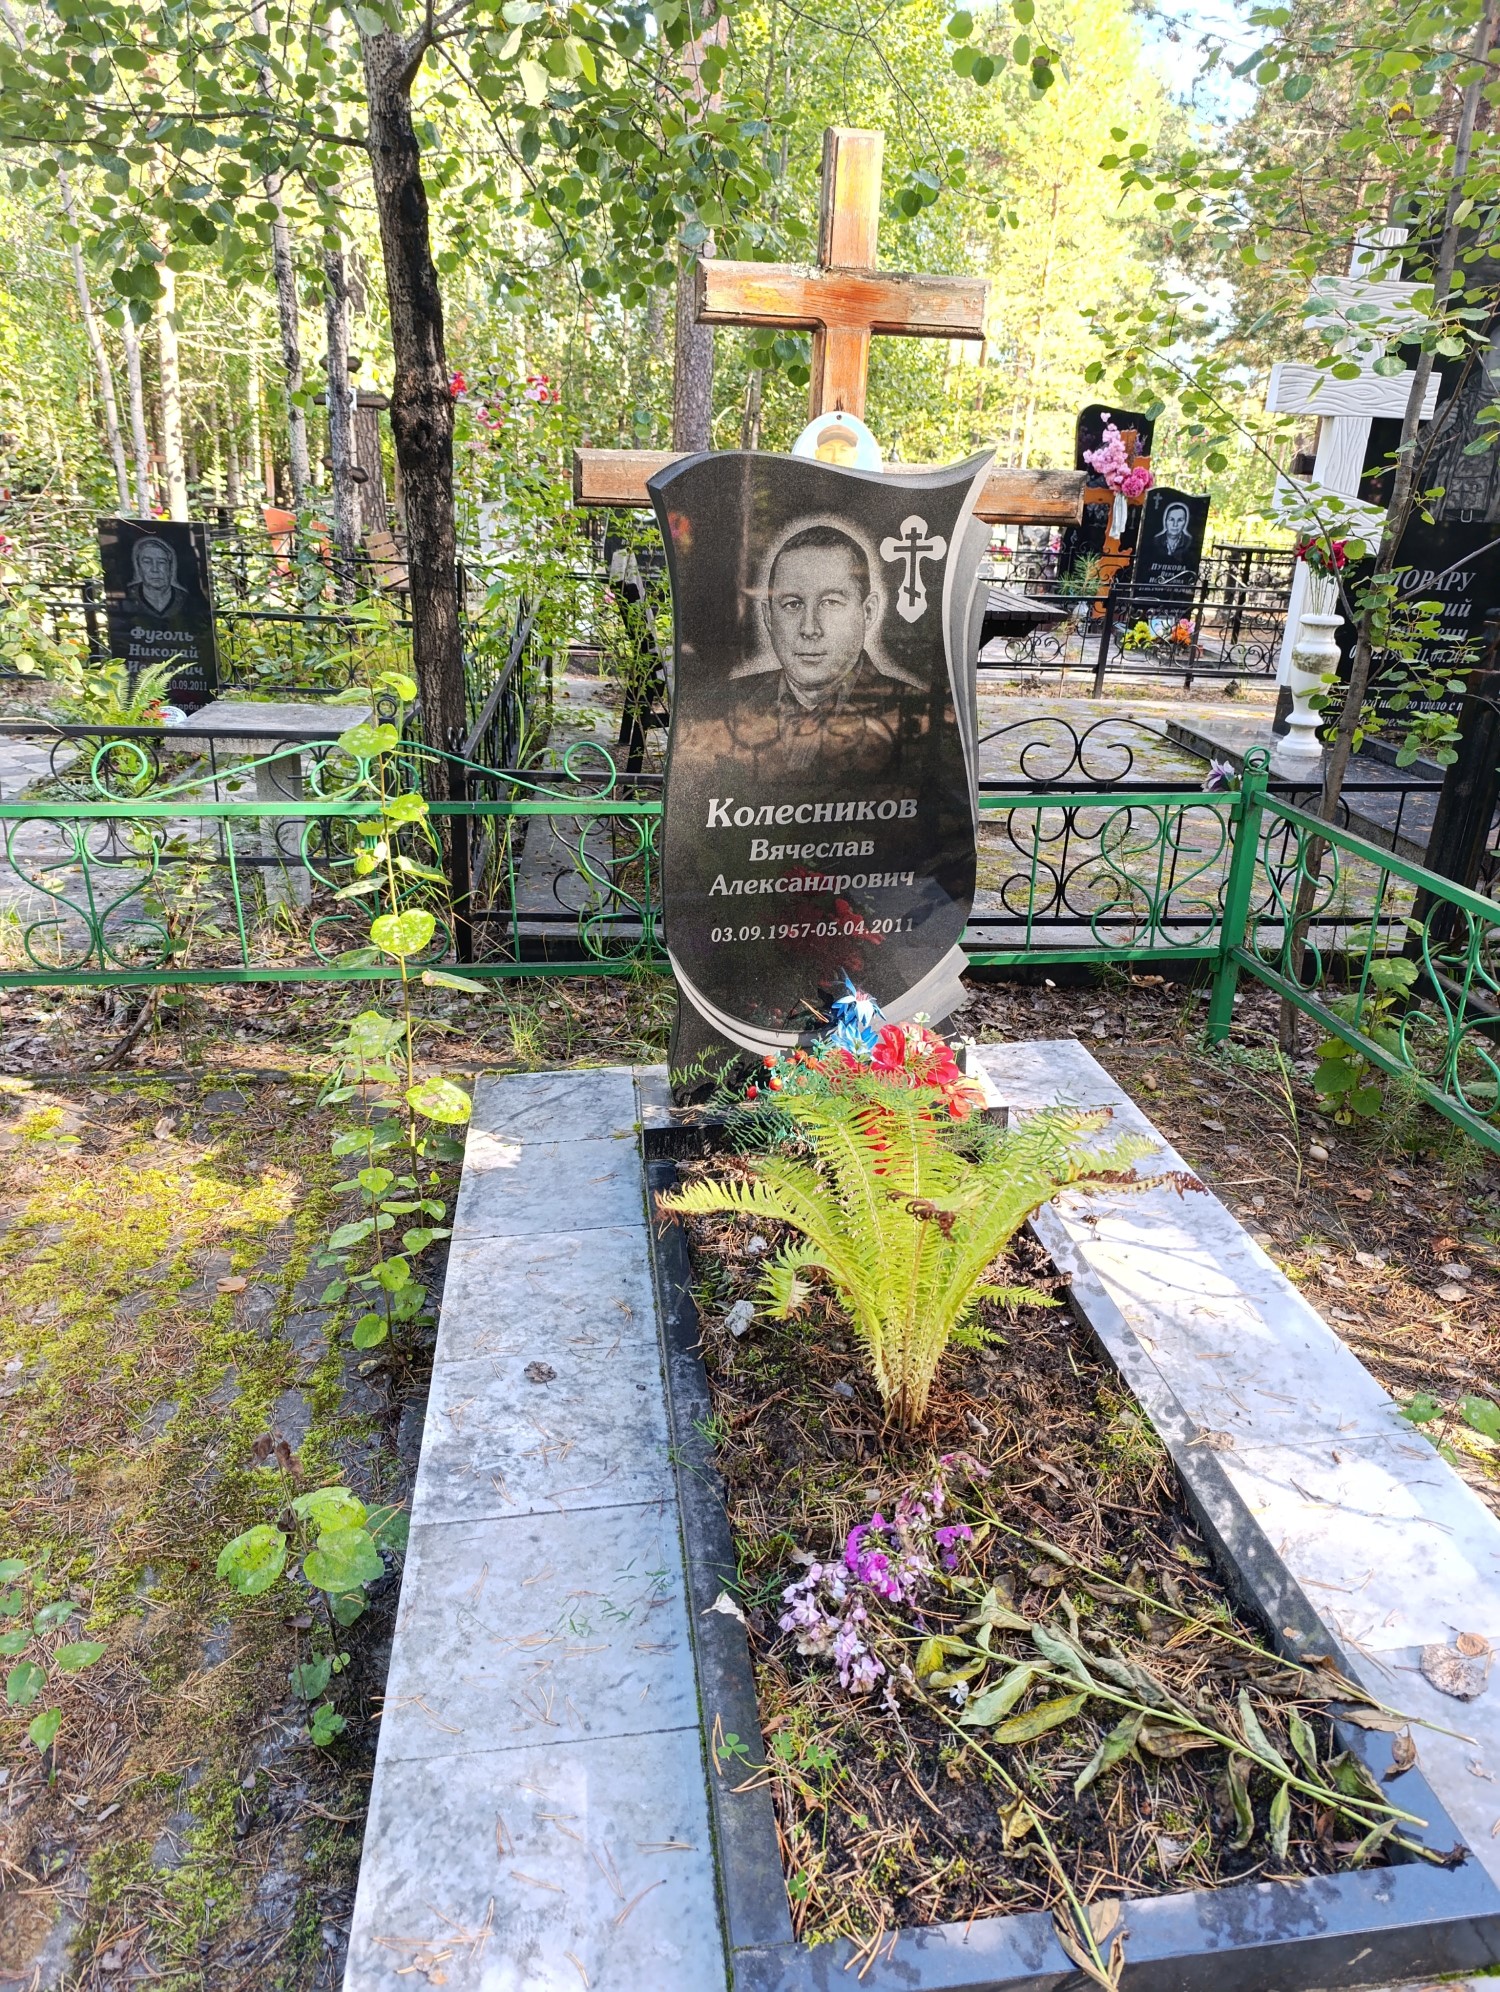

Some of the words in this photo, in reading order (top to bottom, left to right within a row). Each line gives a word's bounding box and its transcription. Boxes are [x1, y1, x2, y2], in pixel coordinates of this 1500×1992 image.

[130, 626, 194, 644] Фуголь
[128, 643, 199, 659] Николай
[706, 798, 918, 828] Колесников
[749, 839, 875, 861] Вячеслав
[708, 871, 915, 896] Александрович
